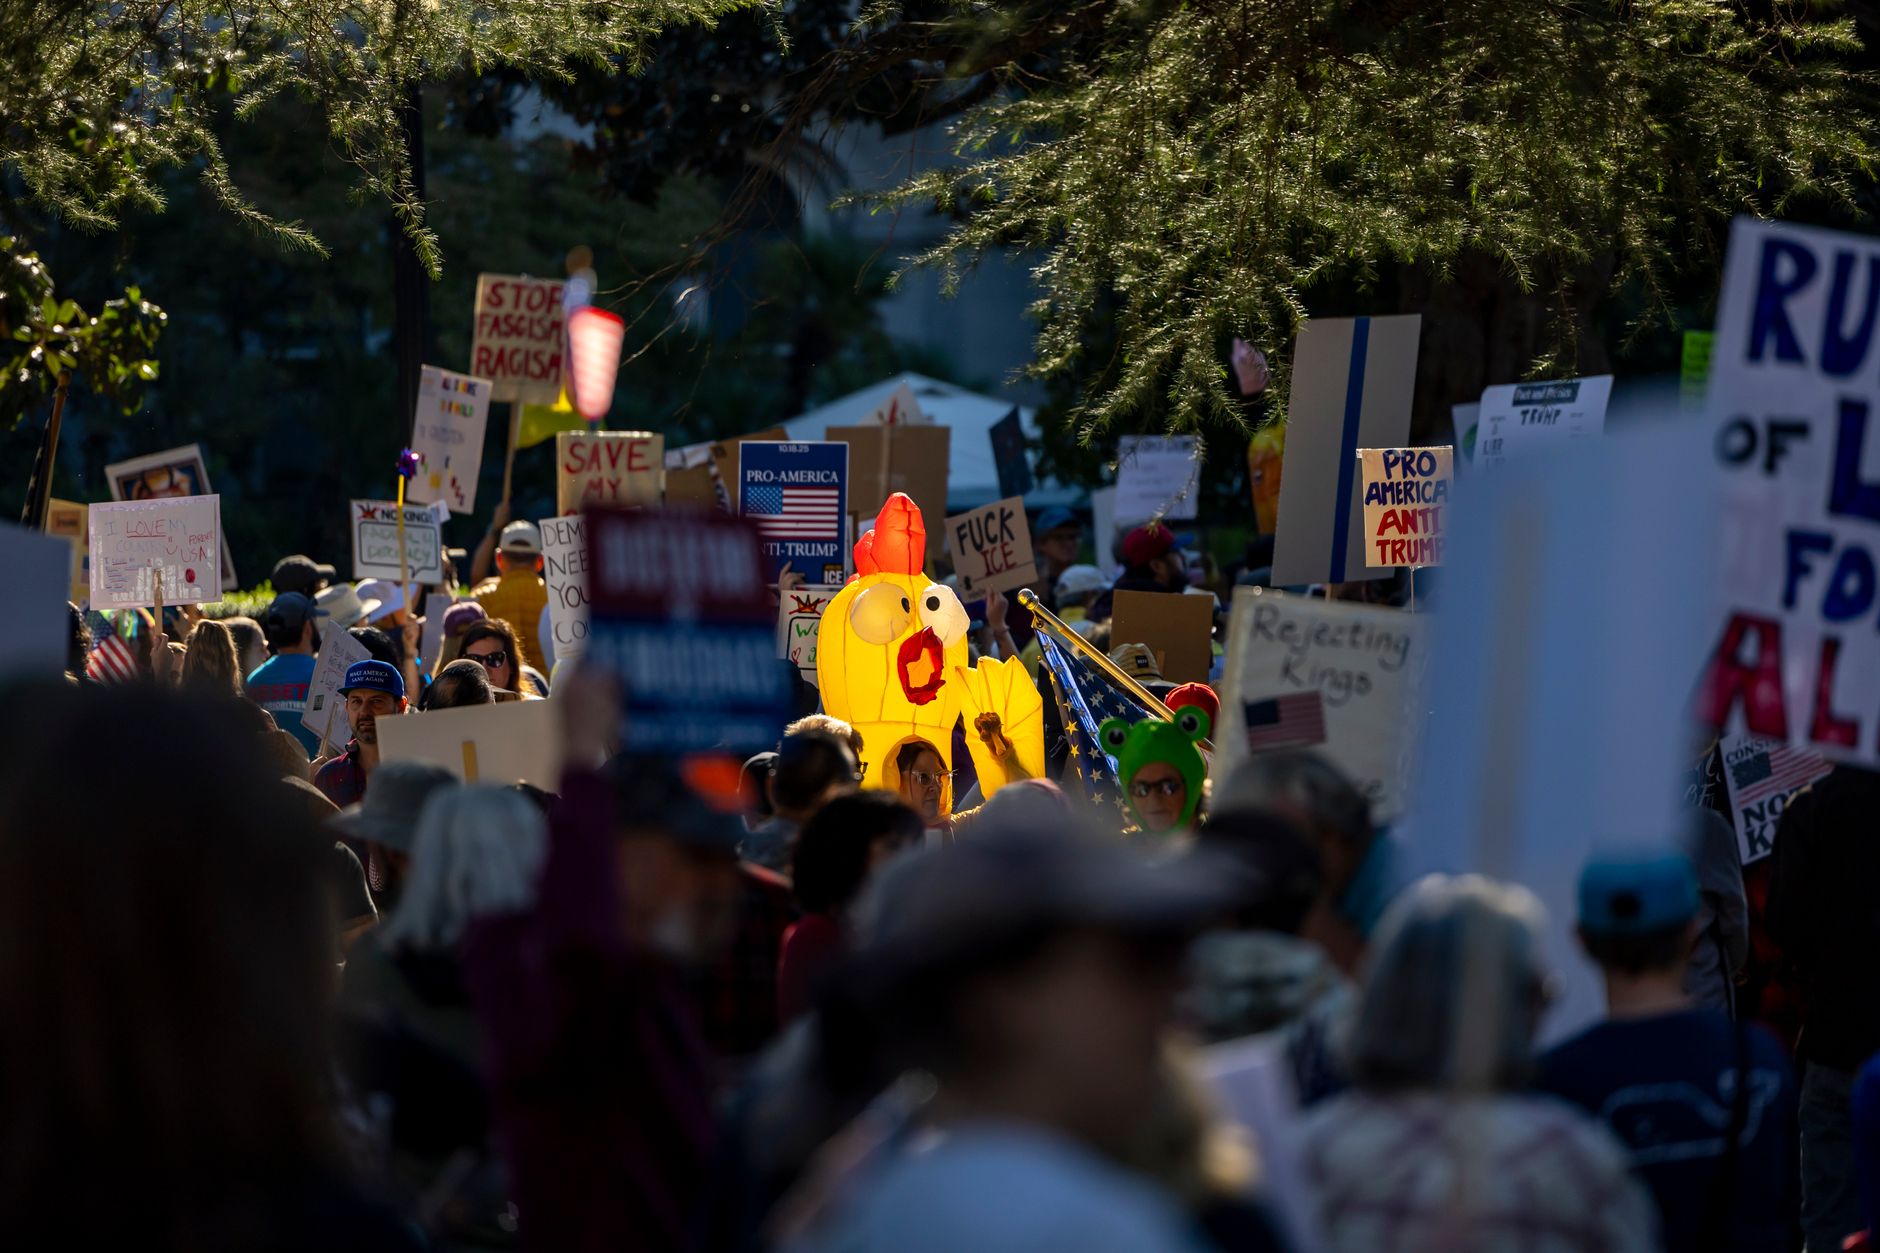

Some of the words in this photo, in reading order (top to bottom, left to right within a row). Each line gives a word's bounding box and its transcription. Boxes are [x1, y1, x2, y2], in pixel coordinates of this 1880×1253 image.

[1747, 236, 1880, 377] RU
[478, 311, 564, 348] FASCISM
[476, 345, 563, 384] RACISM
[1520, 408, 1562, 425] TRUMP
[564, 440, 652, 474] SAVE
[778, 445, 809, 453] 10.18.25
[1715, 417, 1810, 475] OF
[746, 470, 839, 483] PRO-AMERICA
[1382, 449, 1437, 480] PRO
[583, 477, 622, 499] MY
[1364, 479, 1448, 506] AMERICA
[126, 519, 167, 537] LOVE
[956, 507, 1015, 556] FUCK
[1376, 506, 1442, 536] ANTI
[181, 545, 208, 562] USA
[980, 541, 1017, 577] ICE
[1376, 537, 1446, 565] TRUMP
[824, 570, 843, 584] ICE
[1783, 528, 1880, 624] FO
[1252, 603, 1411, 673] Rejecting
[349, 670, 362, 678] MAKE
[363, 669, 389, 678] AMERICA
[365, 676, 385, 684] AGAIN
[1280, 654, 1373, 707] Kings
[1697, 610, 1880, 750] AL
